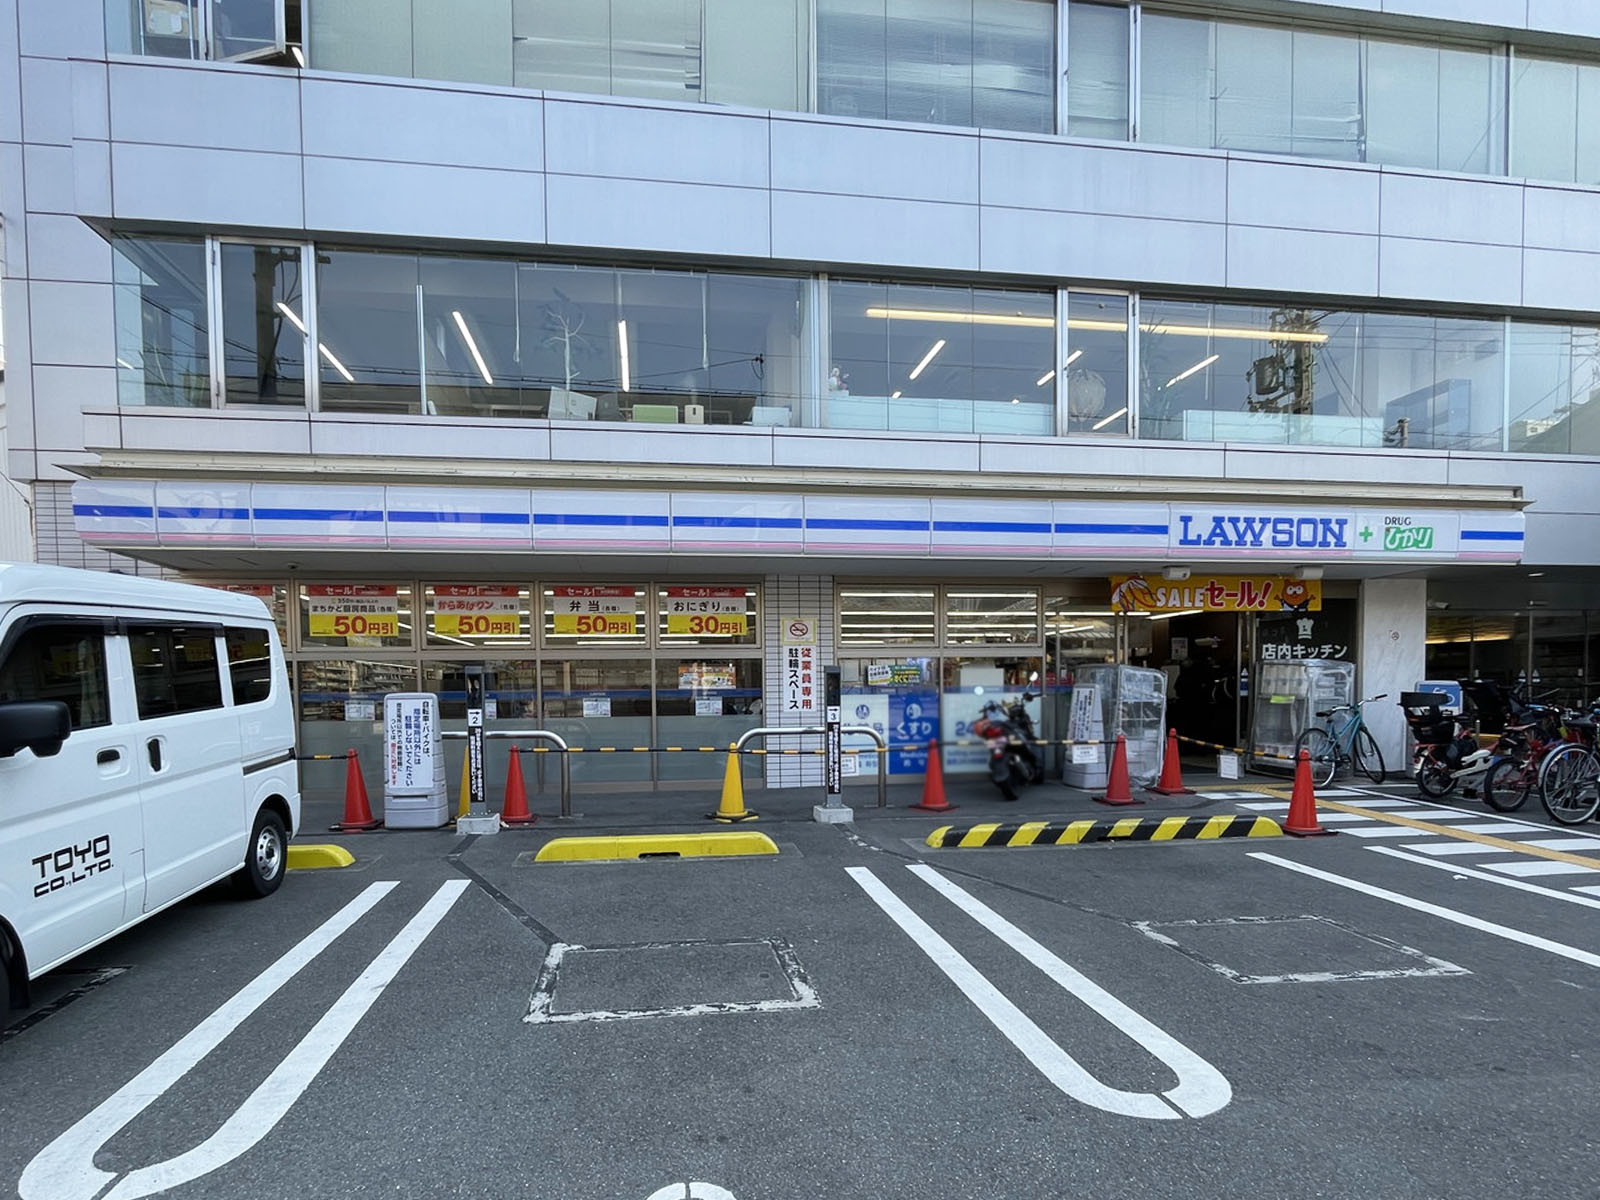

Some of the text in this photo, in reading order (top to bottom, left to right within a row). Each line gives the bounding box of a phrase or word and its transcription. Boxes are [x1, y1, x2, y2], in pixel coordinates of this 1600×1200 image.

[1178, 515, 1348, 548] LAWSON
[1384, 516, 1412, 526] DRUG
[1261, 643, 1349, 660] 店内キッチン
[788, 647, 799, 710] 駐輪スペース
[801, 647, 812, 710] 従業員専用
[472, 716, 479, 725] 2
[830, 712, 837, 721] 3
[32, 834, 110, 879] TOYO
